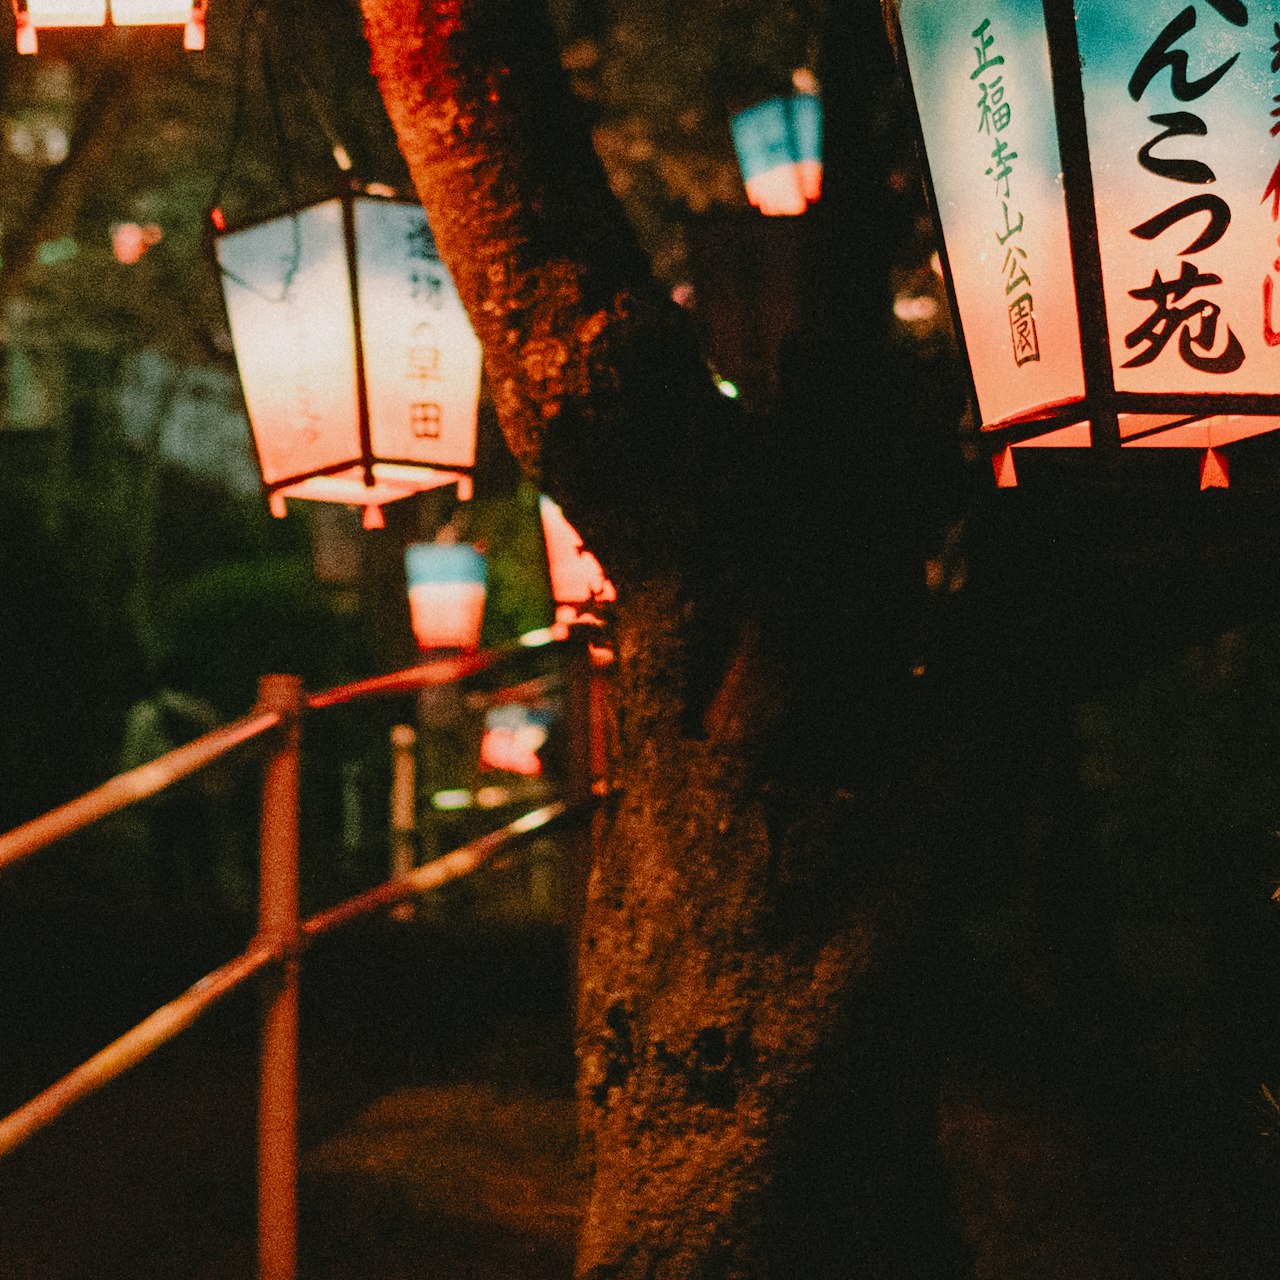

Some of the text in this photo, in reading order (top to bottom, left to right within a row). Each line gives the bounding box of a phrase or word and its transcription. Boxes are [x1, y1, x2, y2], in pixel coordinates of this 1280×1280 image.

[969, 18, 1041, 368] 正福寺山公園
